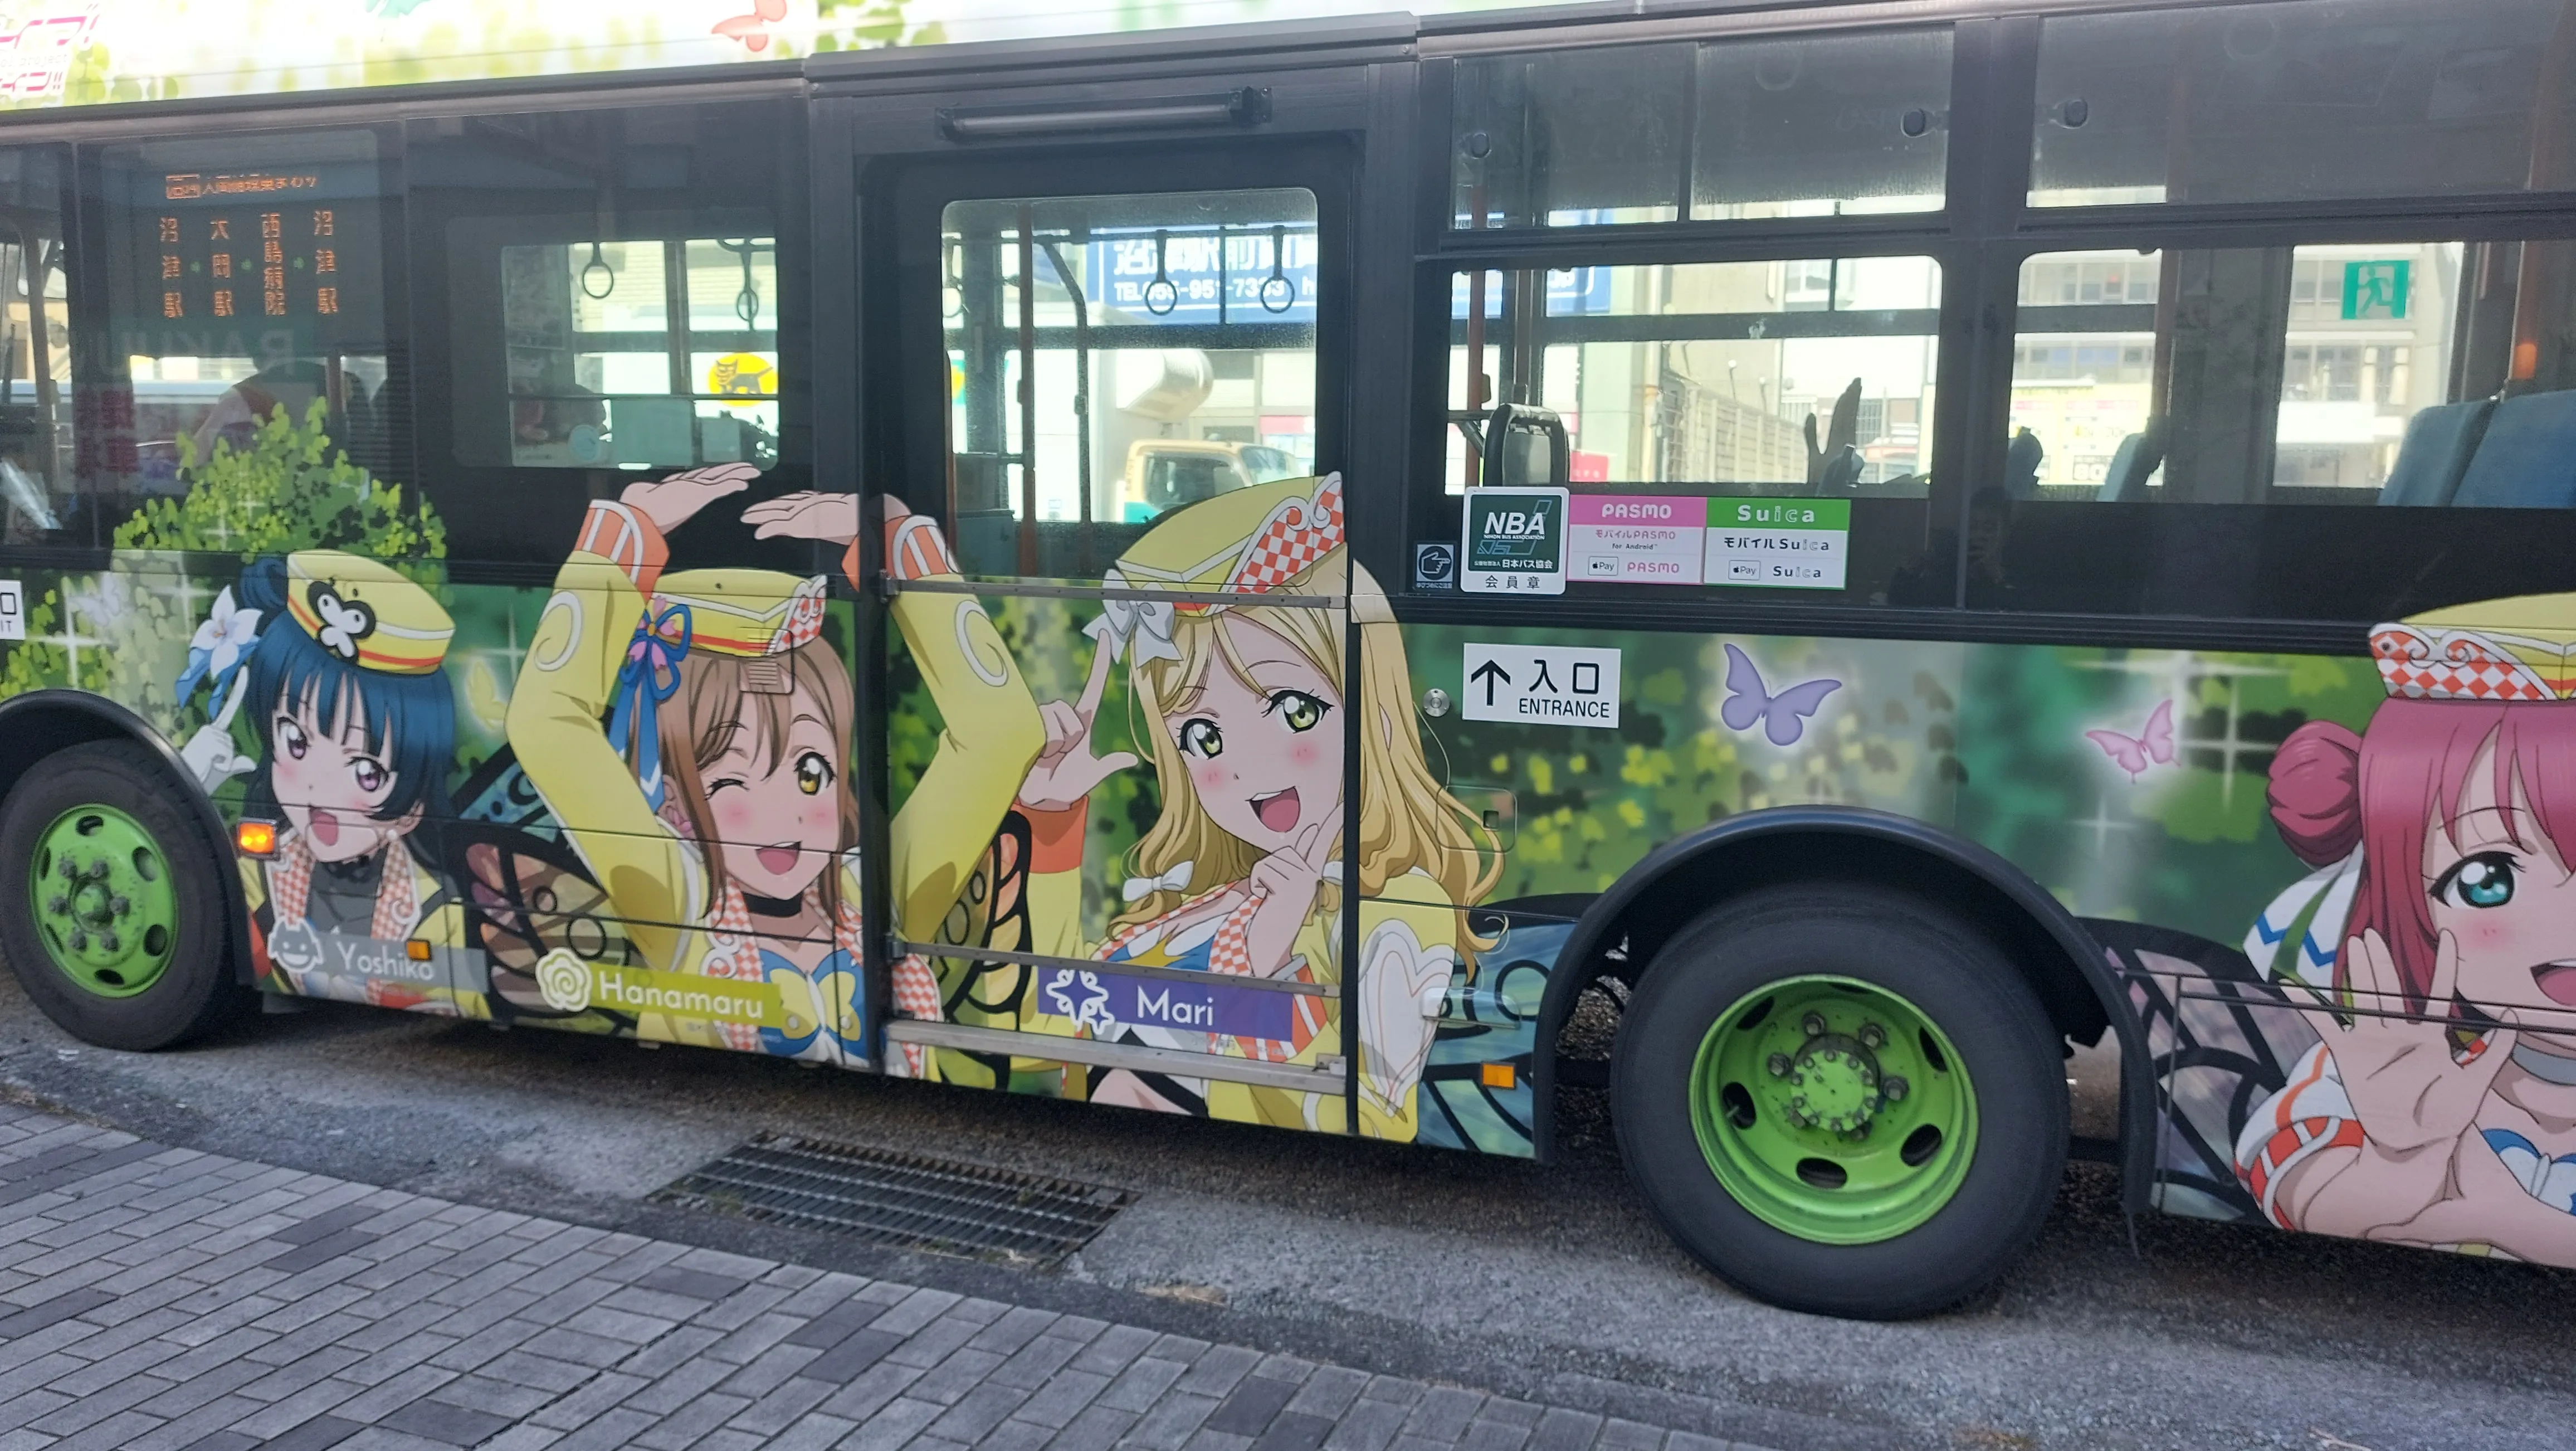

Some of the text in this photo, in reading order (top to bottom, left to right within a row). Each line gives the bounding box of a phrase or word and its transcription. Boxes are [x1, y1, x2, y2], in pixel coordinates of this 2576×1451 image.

[1602, 503, 1672, 519] PASMO
[1737, 504, 1815, 523] Suica
[1484, 512, 1545, 535] NBA
[1595, 529, 1676, 539] モバイルPASMO
[1724, 537, 1829, 551] モバイルSuica
[1502, 559, 1553, 569] 日本バス協会
[1599, 562, 1680, 573] Pay PASMO
[1740, 566, 1822, 578] Pay Suica
[1485, 574, 1540, 590] 会員章
[1529, 659, 1599, 695] 入口
[1519, 698, 1609, 718] ENTRANCE
[336, 941, 434, 981] Yoshiko
[599, 971, 764, 1019] Hanamaru
[1137, 985, 1214, 1026] Mari
